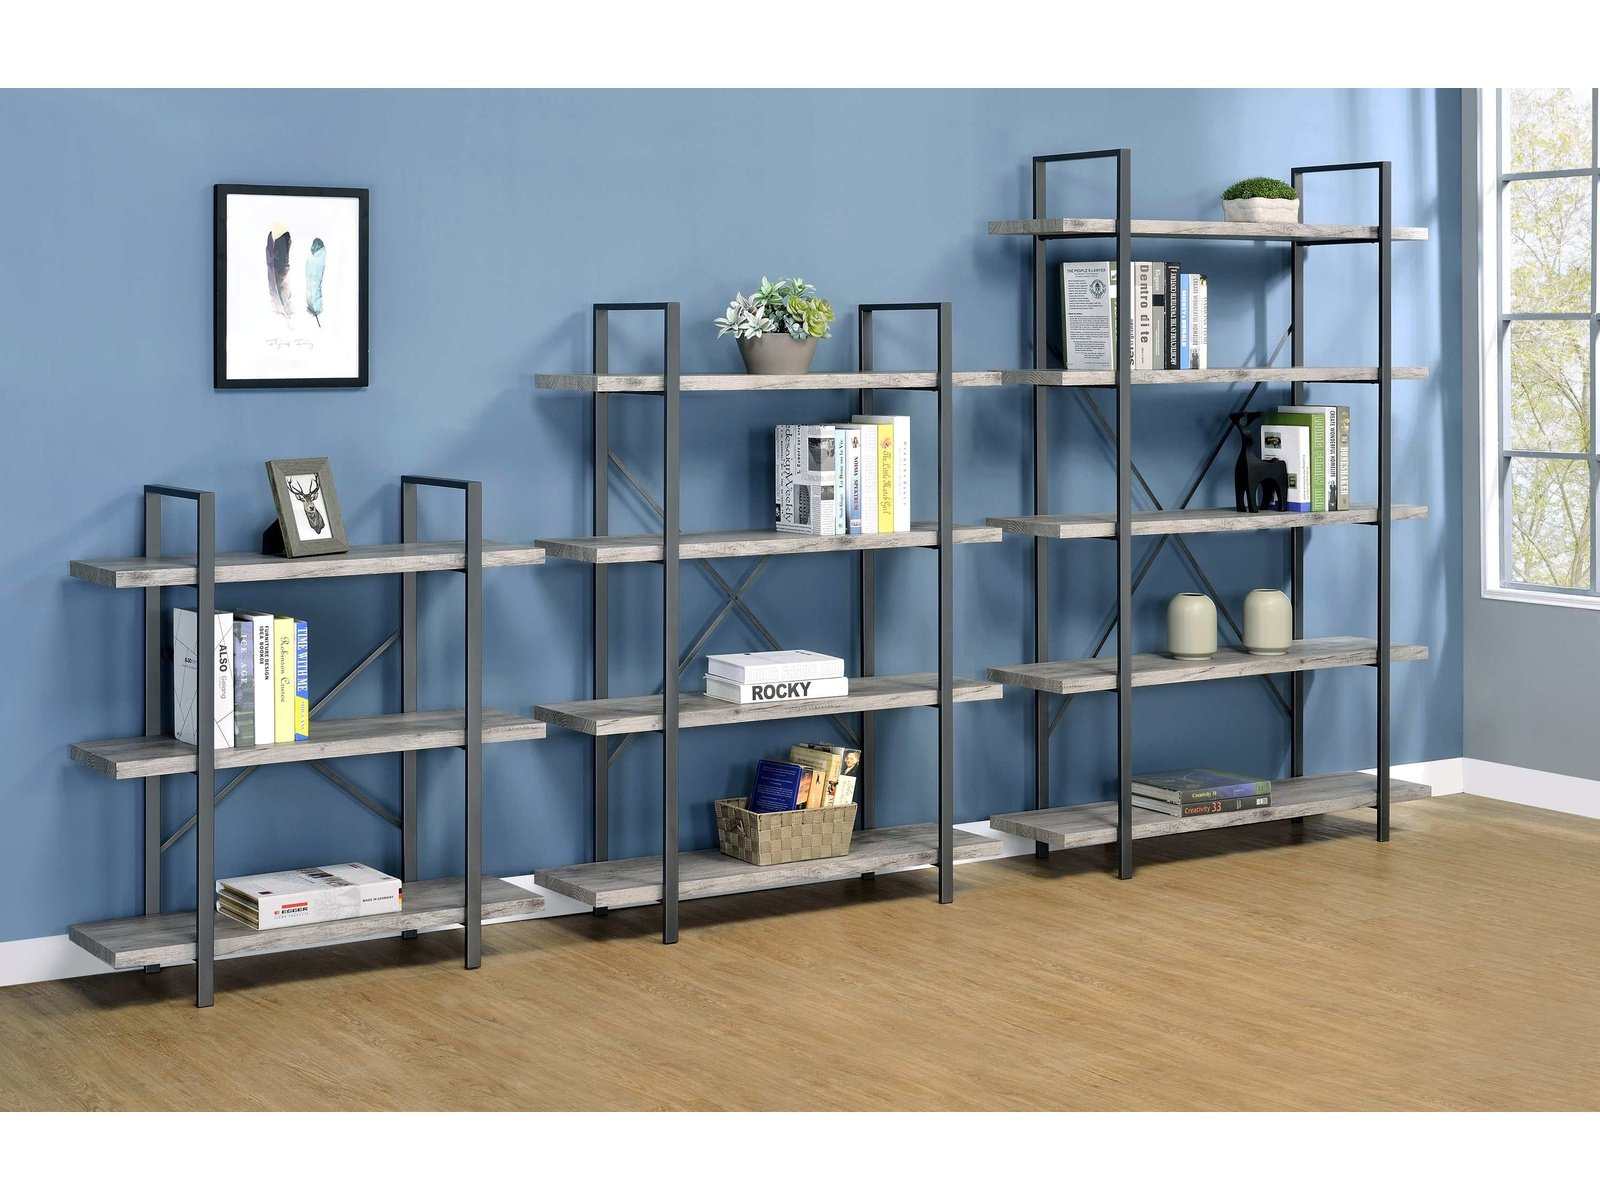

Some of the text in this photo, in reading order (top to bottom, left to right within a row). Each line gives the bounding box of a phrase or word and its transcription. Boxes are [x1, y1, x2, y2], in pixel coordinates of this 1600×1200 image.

[1140, 264, 1150, 308] Dentro
[1140, 314, 1150, 326] di
[1140, 331, 1150, 344] te
[298, 627, 308, 650] TIME
[219, 644, 228, 672] ALSO
[280, 636, 290, 674] Robinson
[298, 652, 308, 675] WITH
[298, 677, 308, 691] ME
[752, 682, 811, 700] ROCKY
[1184, 801, 1222, 814] Creativity 33
